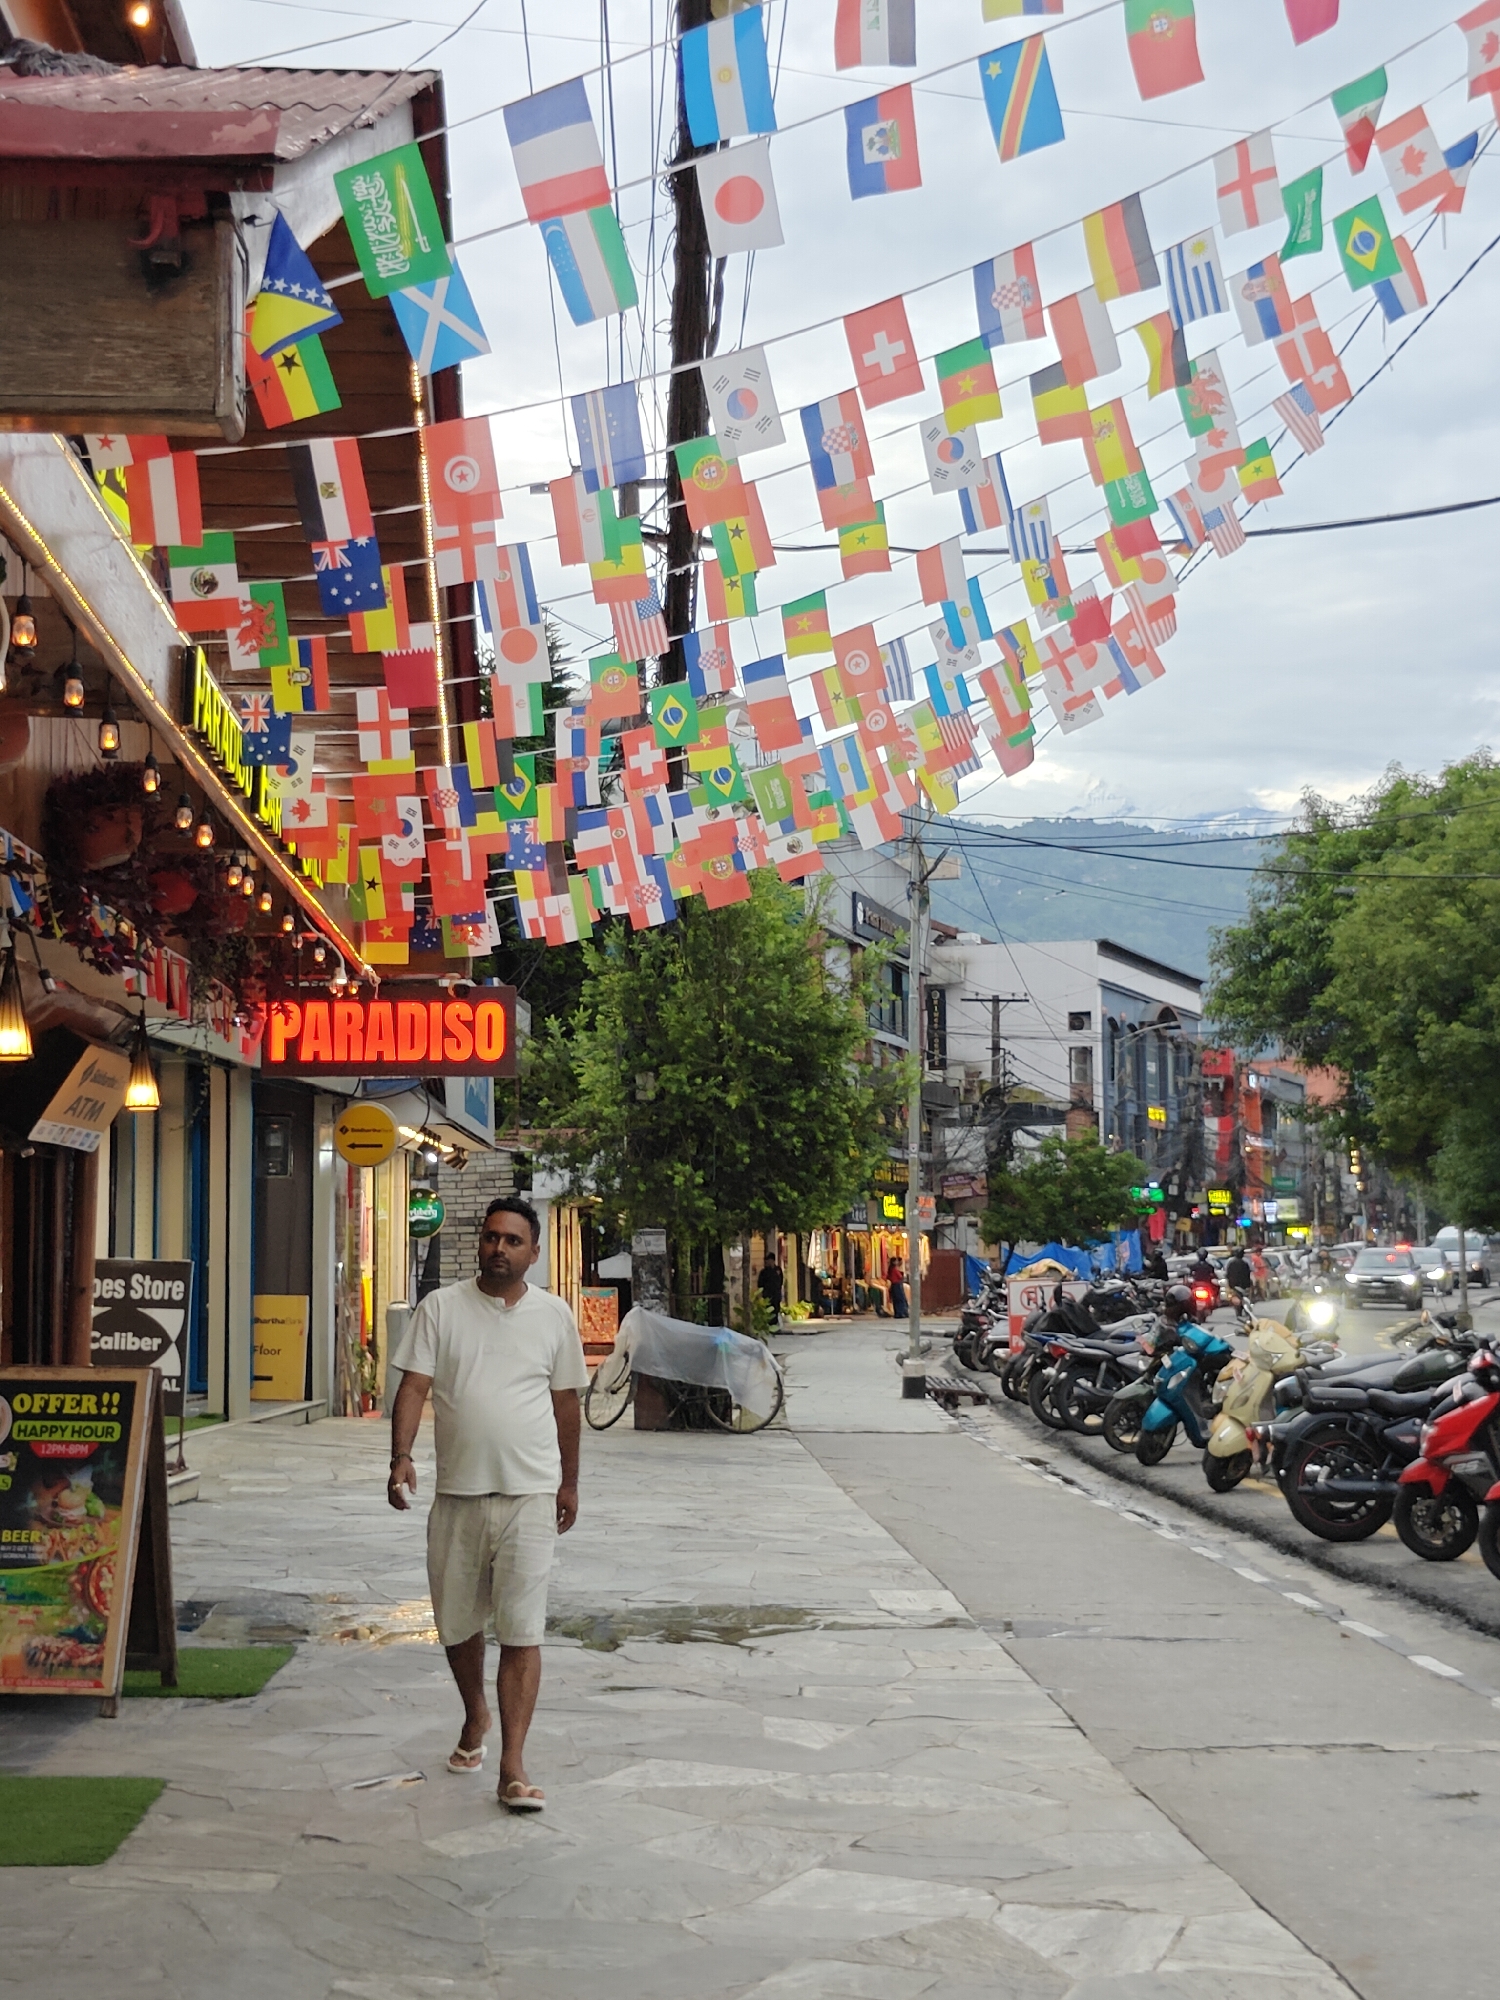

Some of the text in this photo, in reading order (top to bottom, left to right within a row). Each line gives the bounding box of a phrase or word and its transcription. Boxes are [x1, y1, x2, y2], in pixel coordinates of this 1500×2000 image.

[270, 1001, 505, 1062] PARADISO
[63, 1095, 106, 1123] ATM
[130, 1273, 185, 1300] Store
[90, 1331, 162, 1351] Caliber
[12, 1392, 120, 1415] OFFER!!
[17, 1425, 115, 1439] HAPPY HOUR
[41, 1443, 89, 1454] 12PM-8PM
[2, 1530, 41, 1543] BEER
